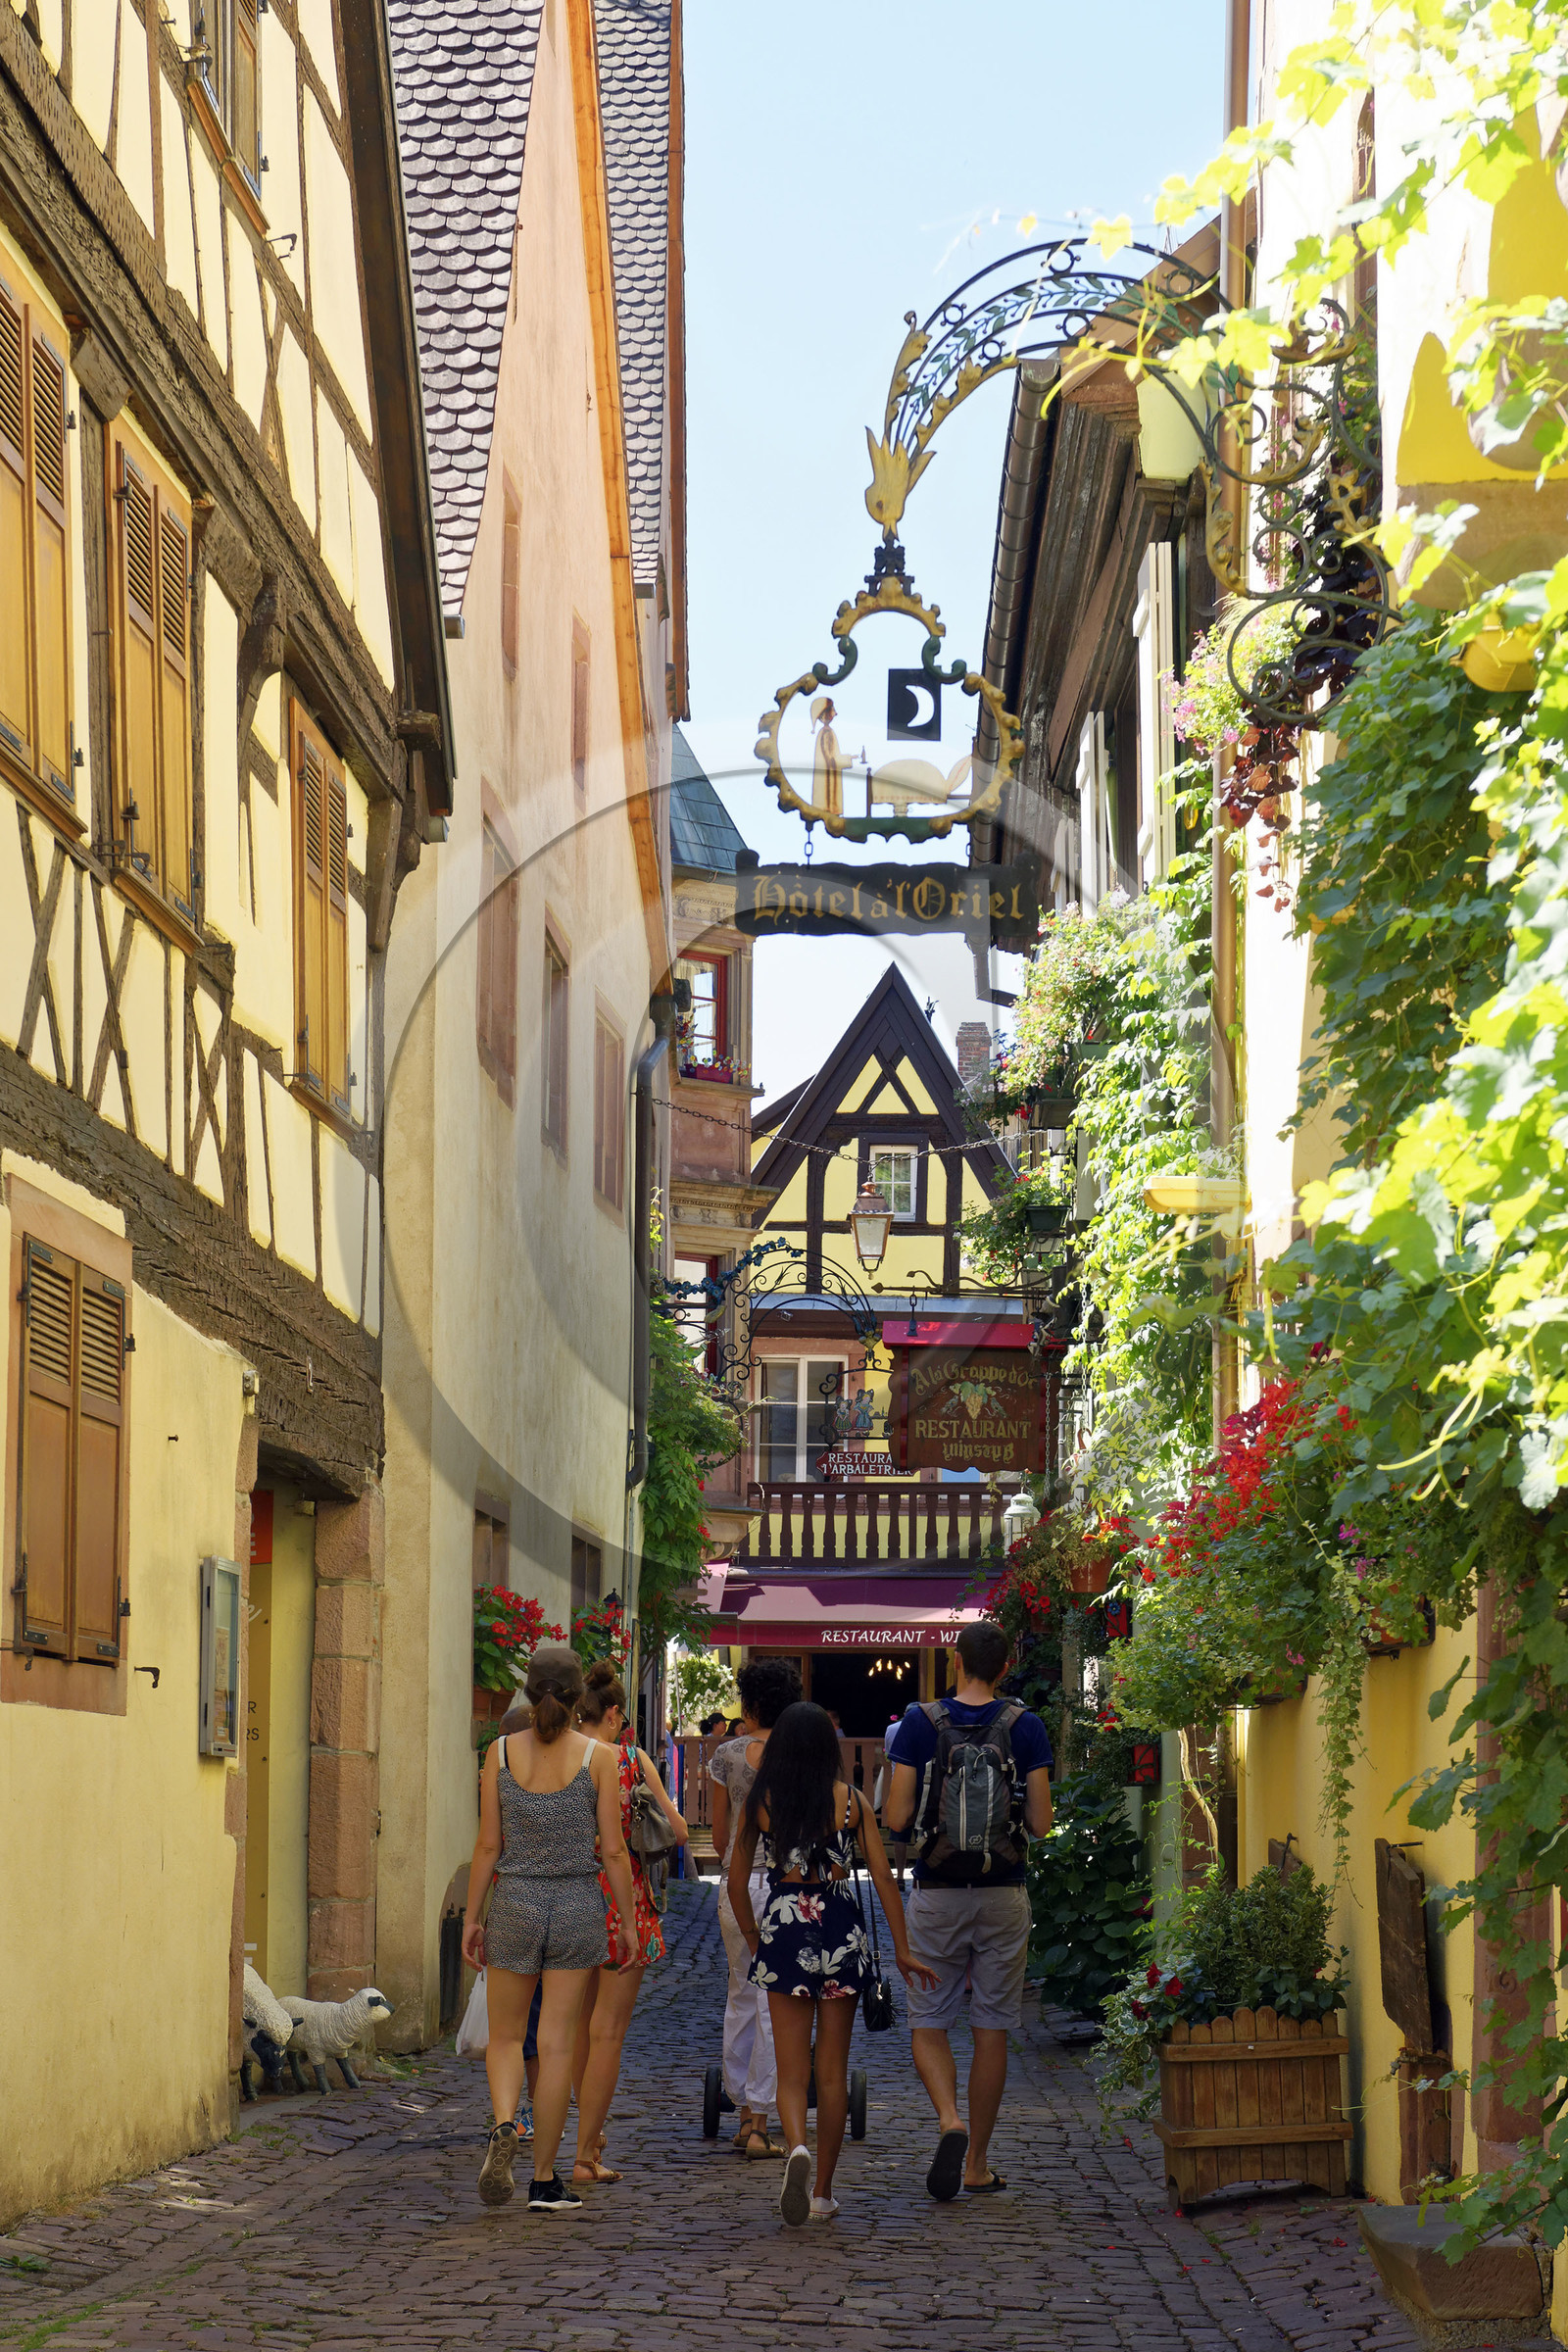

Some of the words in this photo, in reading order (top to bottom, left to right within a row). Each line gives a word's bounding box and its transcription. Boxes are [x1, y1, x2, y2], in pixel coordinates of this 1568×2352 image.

[753, 874, 864, 926] Hôtel
[895, 876, 1025, 920] l'Oriel
[943, 1358, 1007, 1383] Grappe
[915, 1419, 1032, 1439] RESTAURANT
[828, 1452, 893, 1464] RESTAURA
[821, 1630, 926, 1643] RESTAURANT
